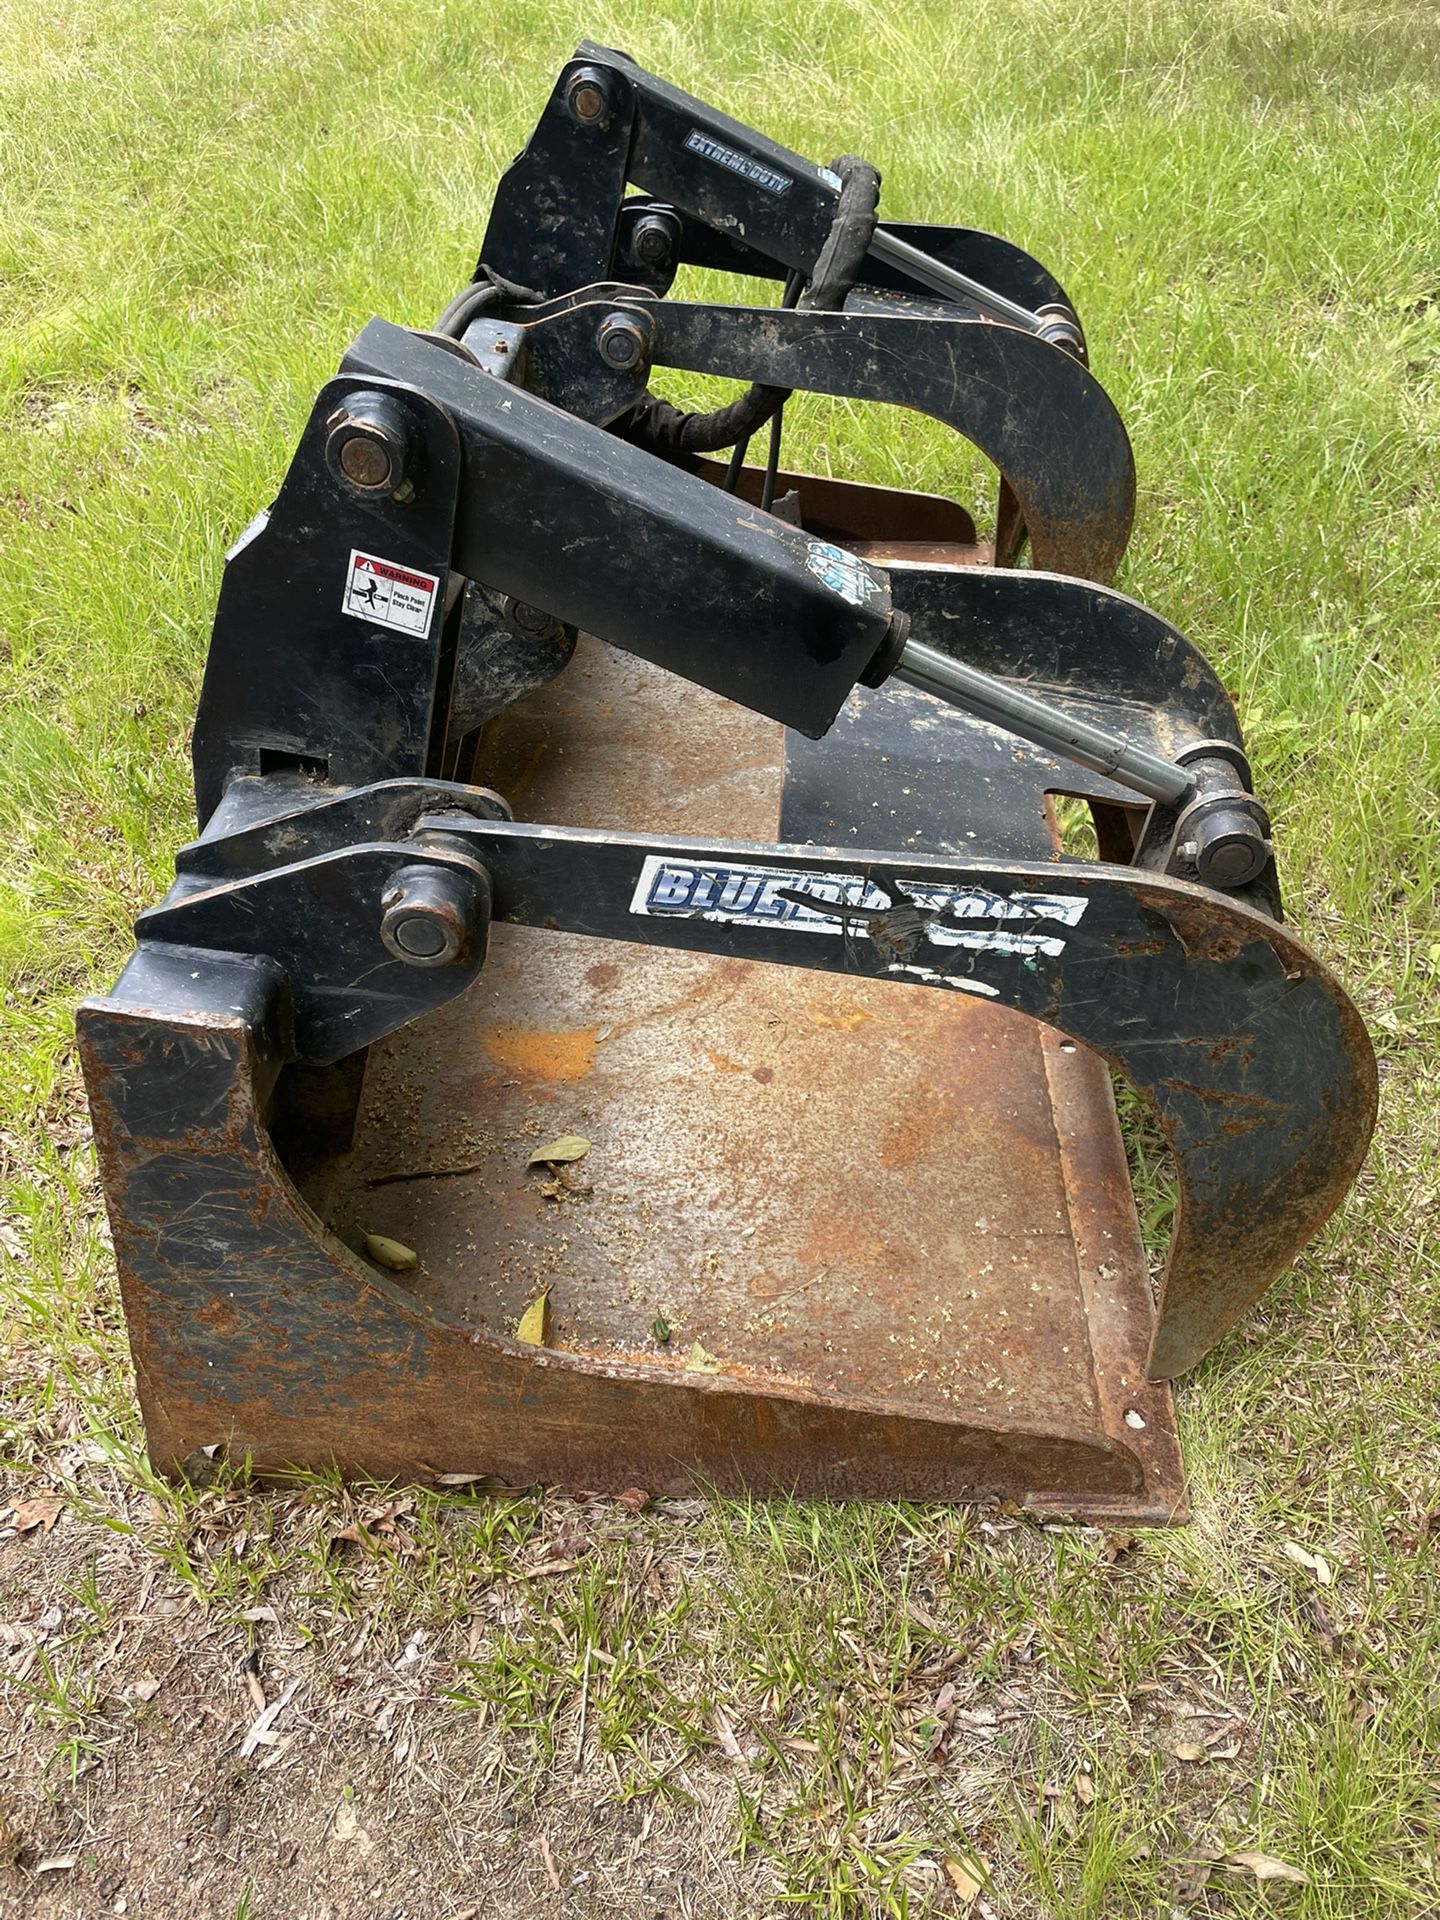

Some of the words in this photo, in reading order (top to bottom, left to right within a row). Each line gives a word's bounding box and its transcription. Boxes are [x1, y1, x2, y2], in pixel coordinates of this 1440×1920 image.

[688, 134, 753, 174] EXTREME
[748, 165, 789, 191] DUTY
[380, 567, 427, 588] WARNING
[392, 599, 405, 609] Stay
[405, 603, 422, 613] Clear
[393, 591, 410, 601] Pinch
[410, 596, 425, 607] Point
